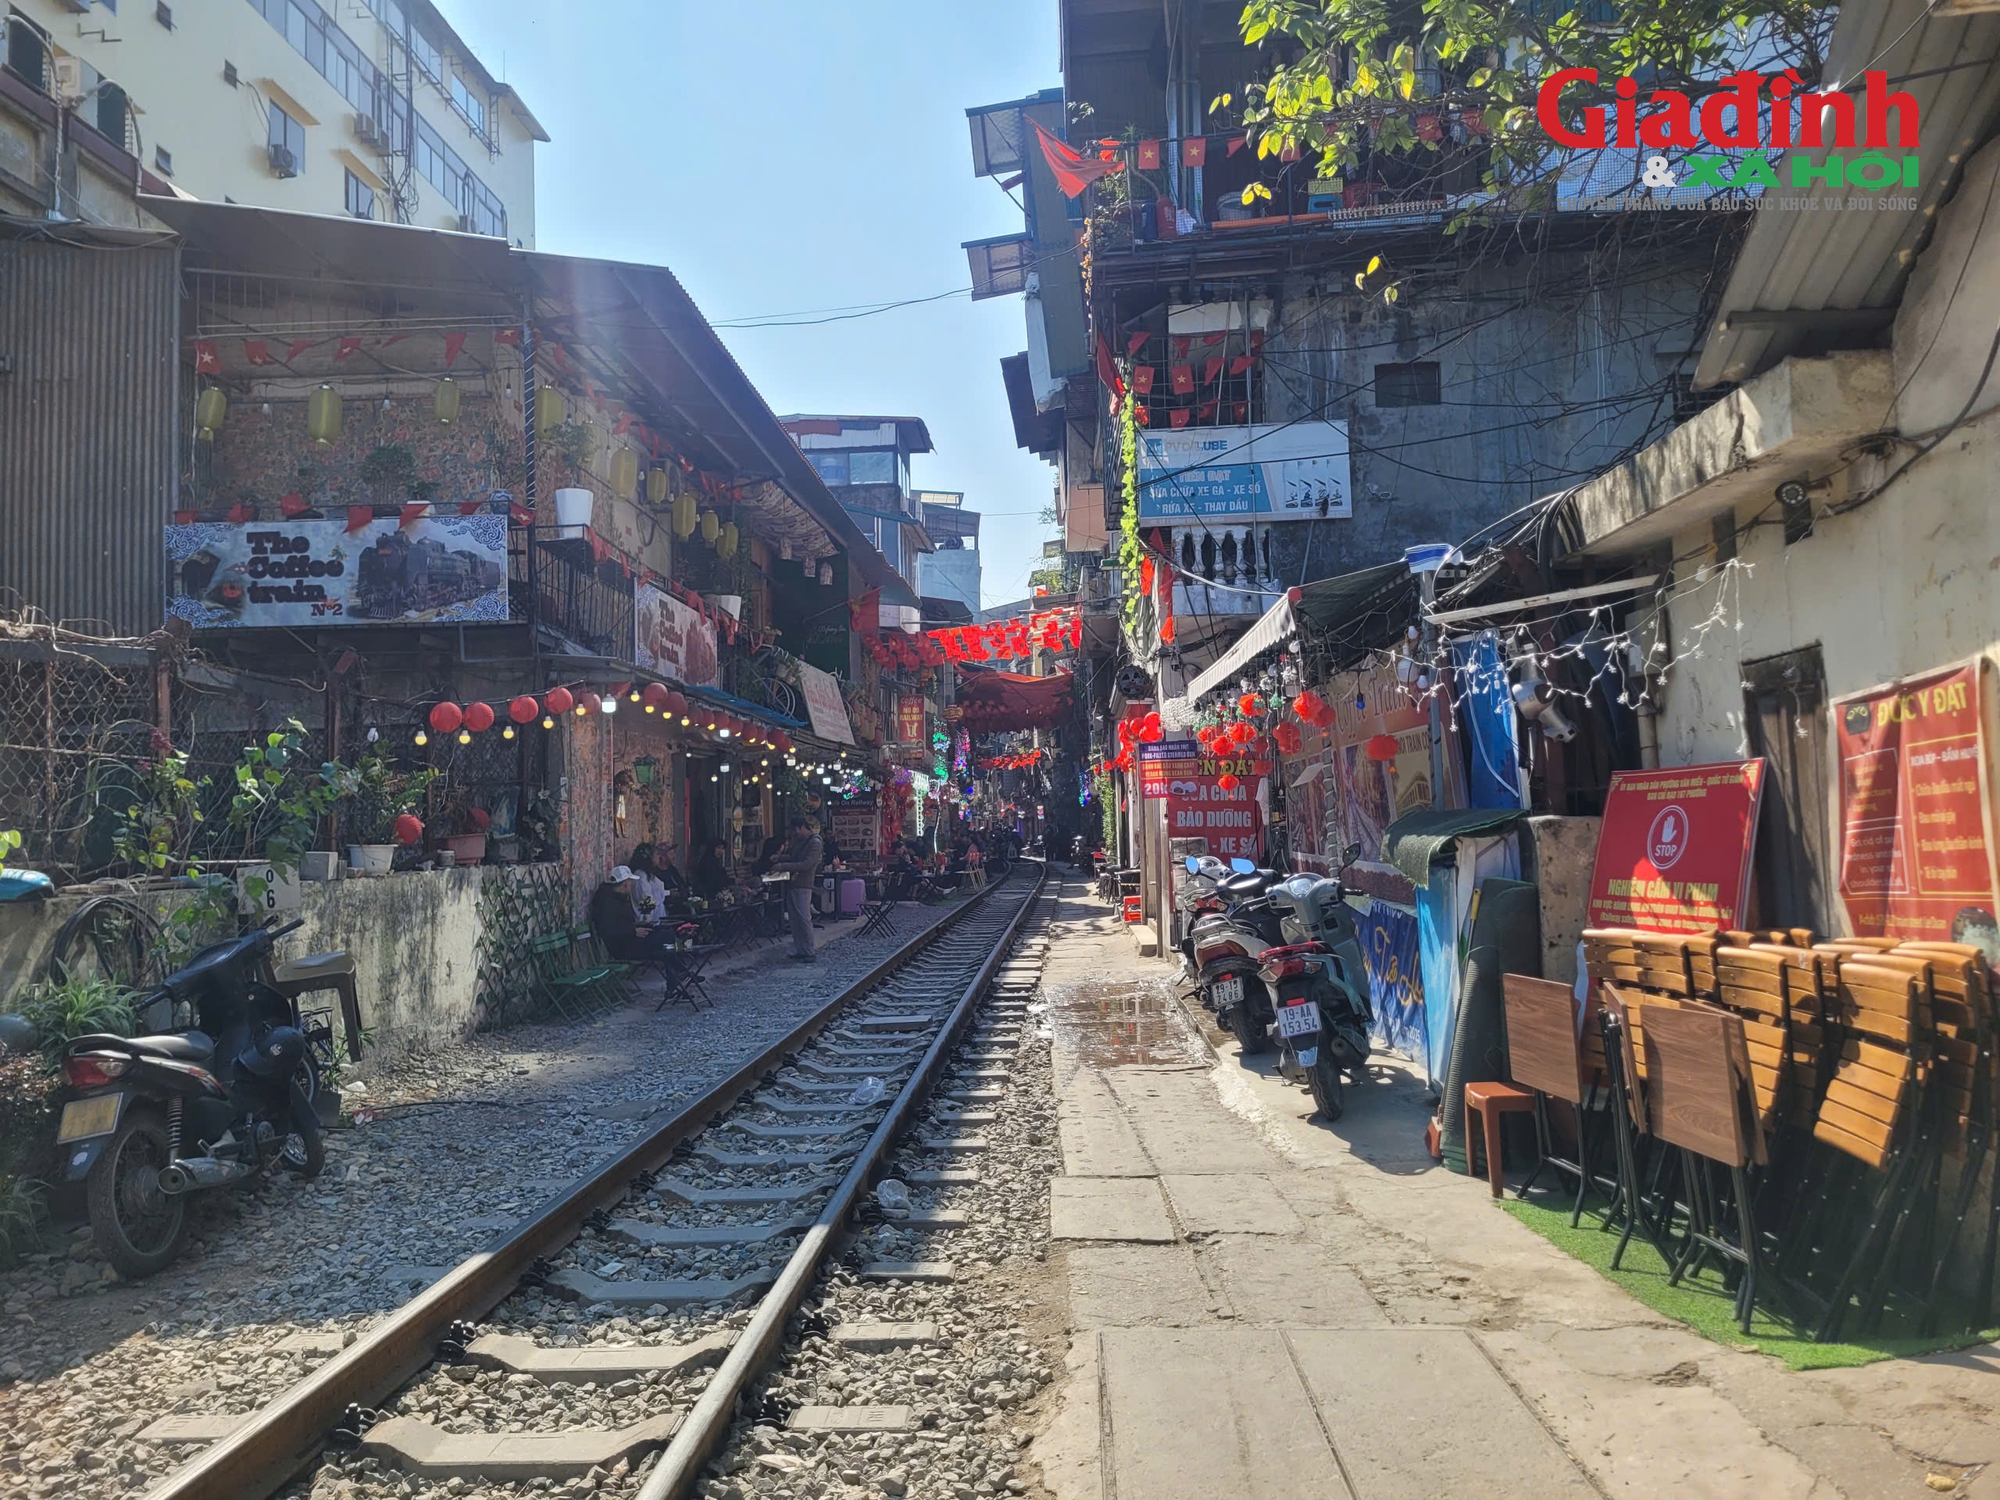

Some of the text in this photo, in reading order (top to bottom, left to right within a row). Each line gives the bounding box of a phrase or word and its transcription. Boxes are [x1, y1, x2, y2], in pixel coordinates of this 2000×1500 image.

[1198, 486, 1209, 496] XE
[1212, 485, 1224, 496] GA
[1233, 484, 1245, 494] XE
[1248, 480, 1260, 494] SỐ
[1205, 501, 1226, 512] THAY
[246, 531, 310, 554] The
[247, 556, 345, 579] Coffee
[1918, 690, 1929, 716] Y
[1933, 682, 1967, 718] ĐẠT
[1177, 806, 1252, 828] BẢO DƯỠNG
[1220, 837, 1236, 854] XE
[1655, 844, 1678, 856] STOP
[1608, 876, 1719, 905] NGHIÊM CẤM VI PHẠM
[1284, 1005, 1312, 1022] 19-AA
[1282, 1022, 1318, 1036] 153.54
